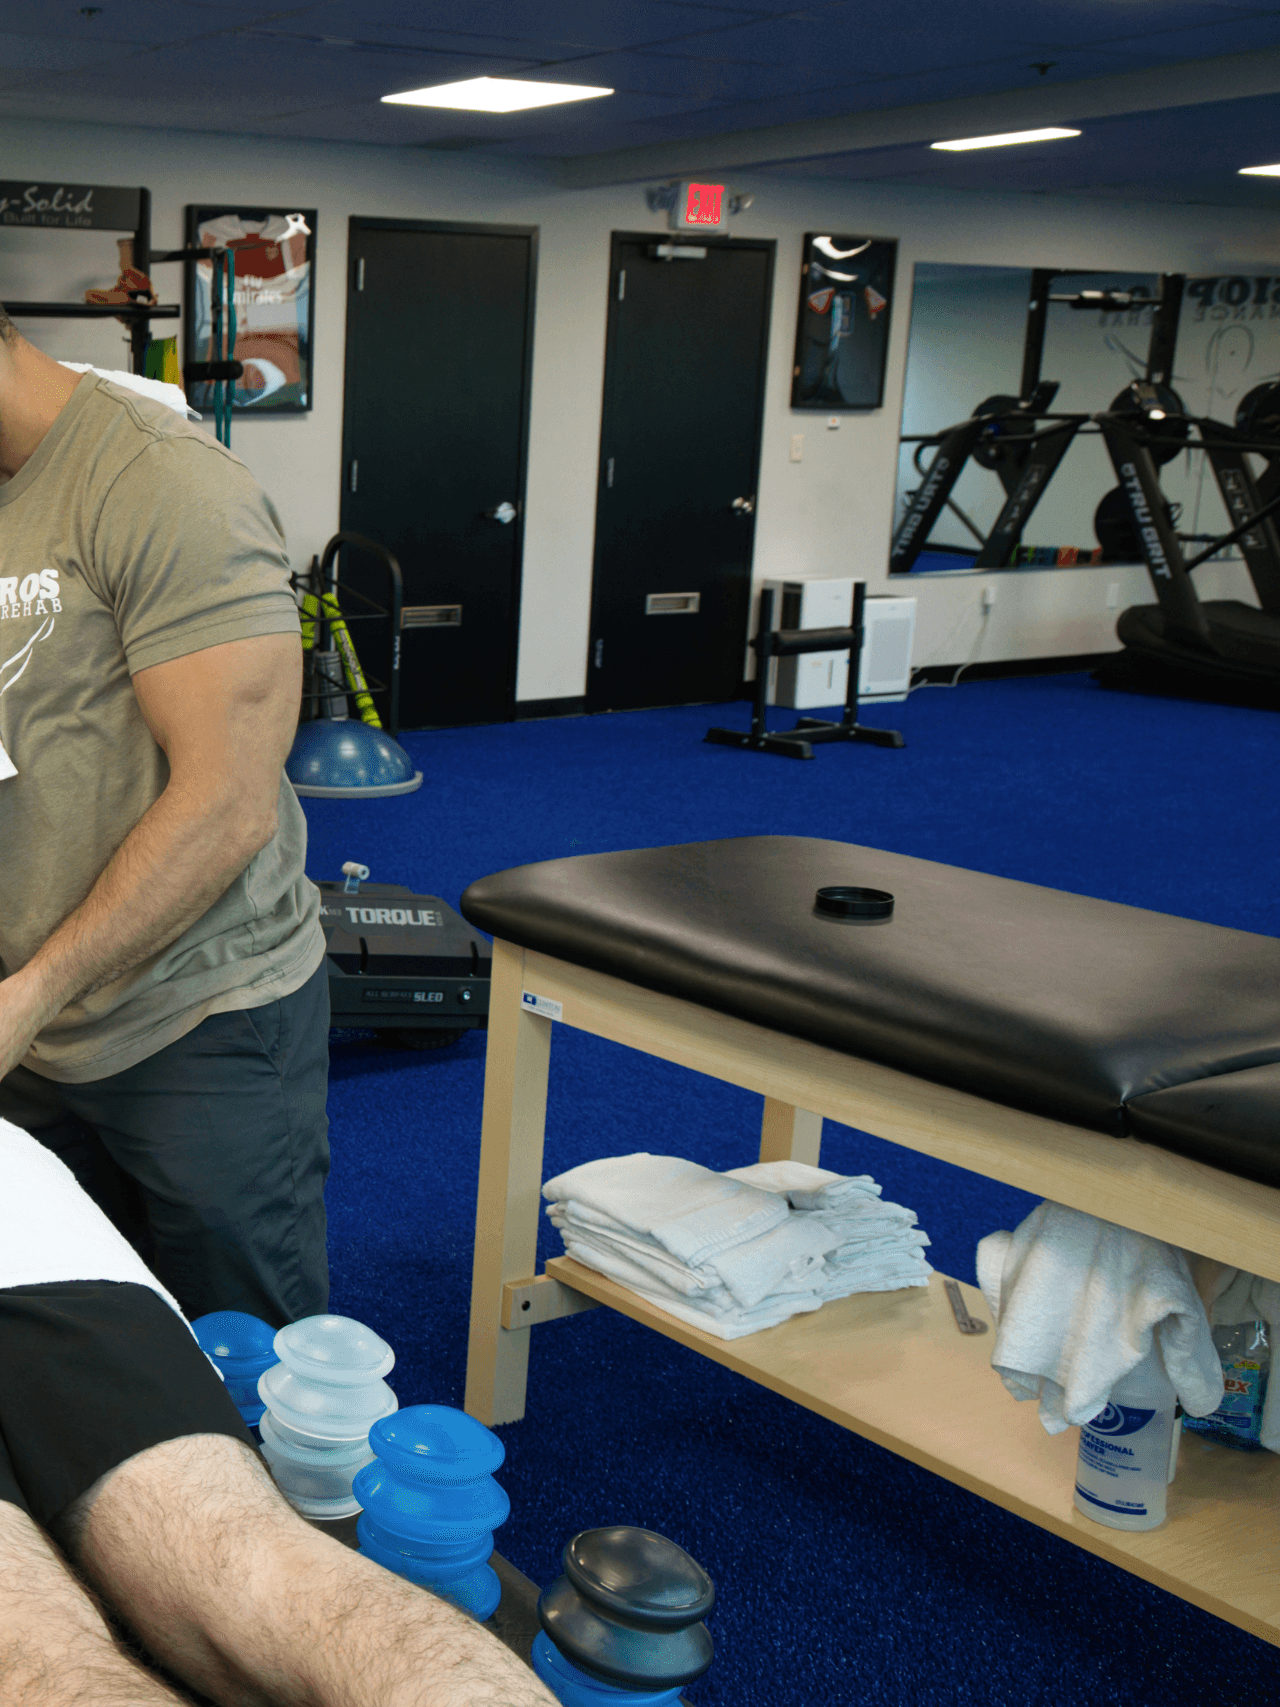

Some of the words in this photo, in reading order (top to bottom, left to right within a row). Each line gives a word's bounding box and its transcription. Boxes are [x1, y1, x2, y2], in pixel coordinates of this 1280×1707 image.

[686, 183, 725, 225] EXIT
[1126, 476, 1153, 523] TRU
[1141, 526, 1173, 579] GRIT
[0, 598, 63, 620] REHAB
[345, 906, 437, 927] TORQUE
[414, 991, 444, 1003] SLED
